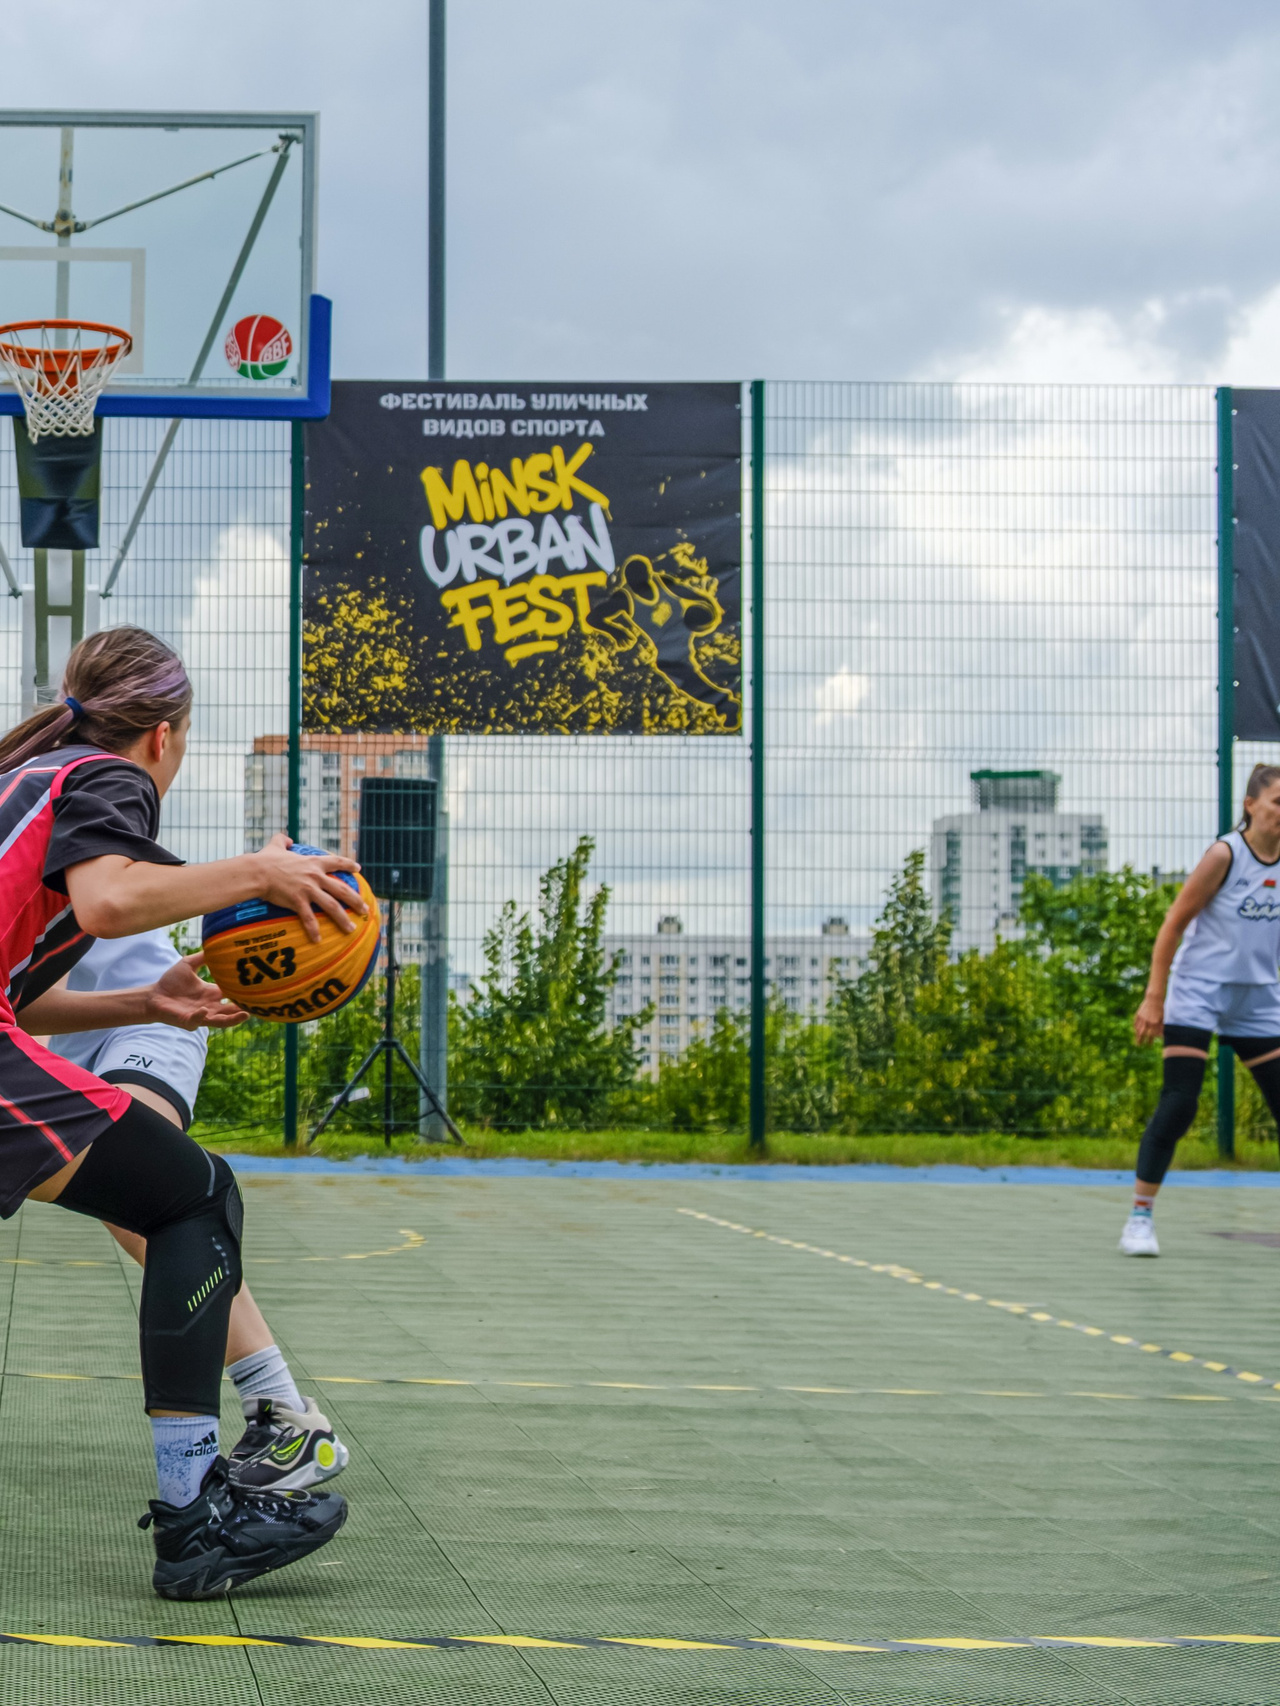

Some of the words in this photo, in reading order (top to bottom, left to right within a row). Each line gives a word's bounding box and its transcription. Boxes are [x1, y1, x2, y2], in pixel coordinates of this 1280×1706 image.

[263, 332, 290, 362] BBF
[379, 393, 526, 410] ФЕСТИВАЛЬ
[531, 393, 648, 411] УЛИЧНЫХ
[423, 419, 506, 438] ВИДОВ
[511, 419, 605, 436] СПОРТА
[421, 502, 615, 588] URBAN
[441, 571, 607, 651] FEST
